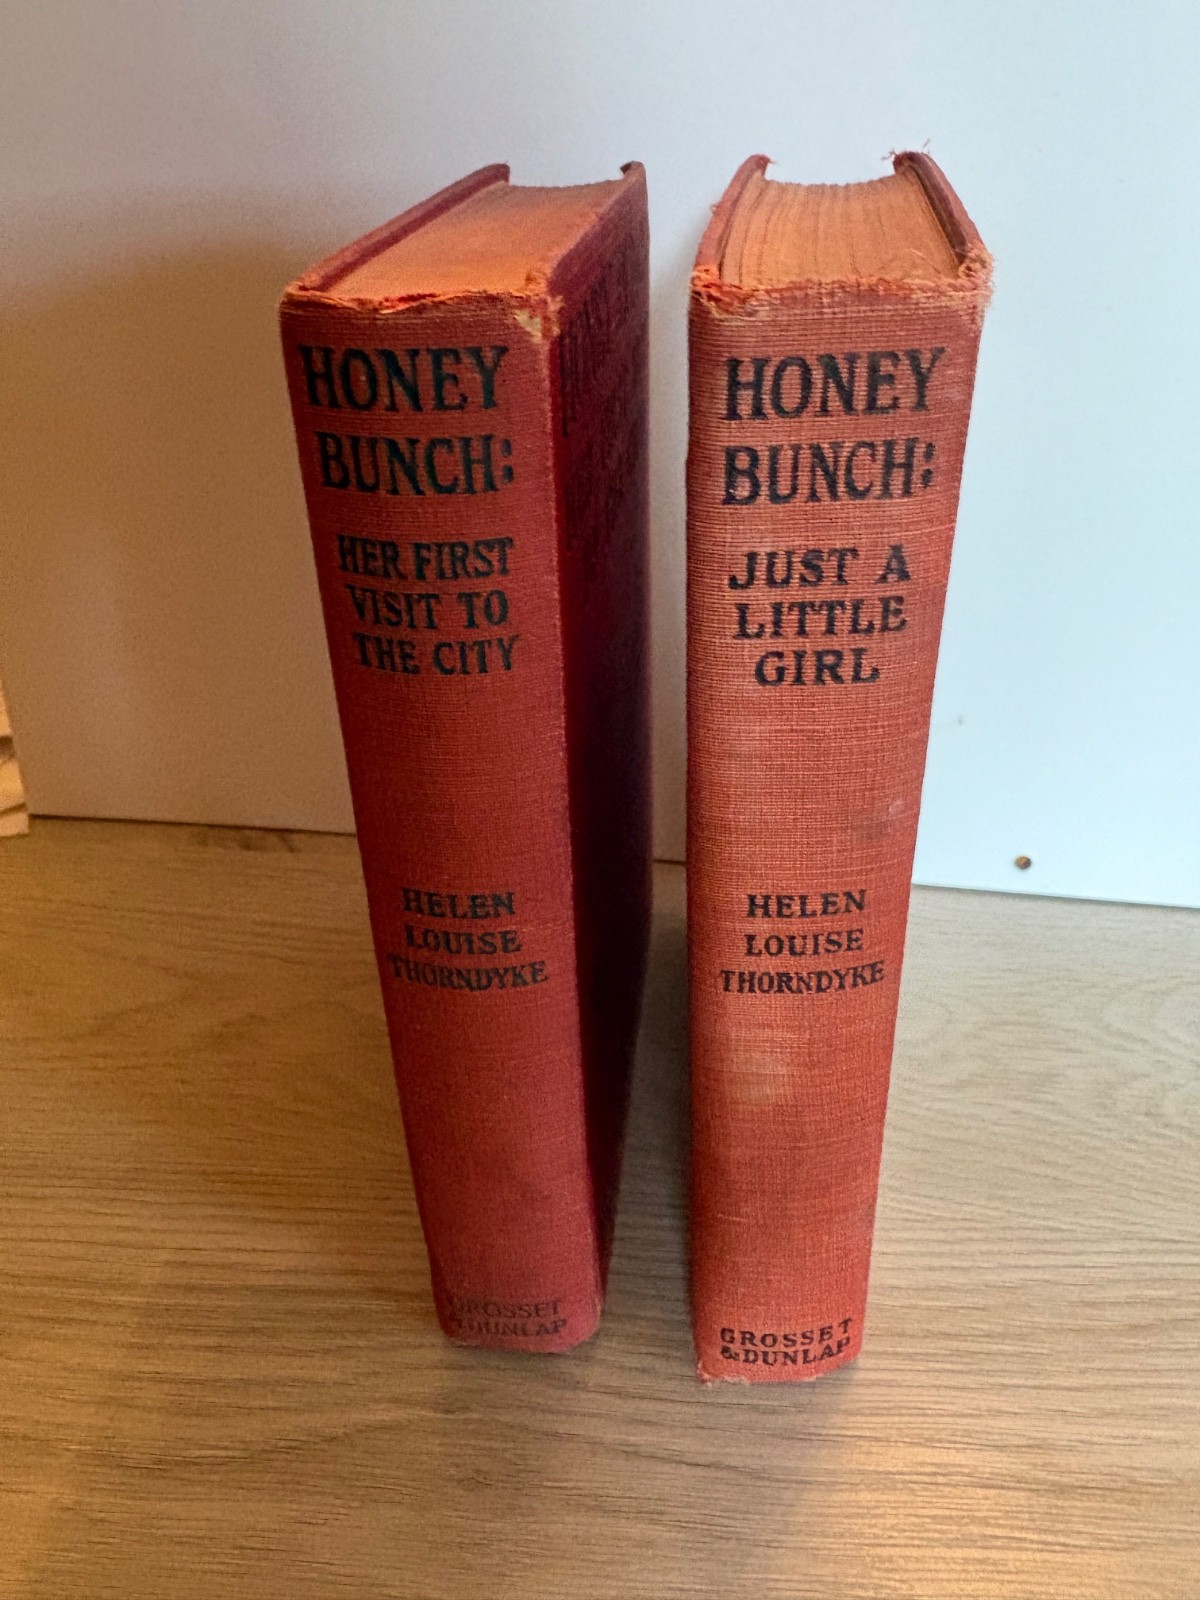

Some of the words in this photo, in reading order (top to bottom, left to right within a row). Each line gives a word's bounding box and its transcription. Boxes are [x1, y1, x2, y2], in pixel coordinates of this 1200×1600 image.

[297, 345, 509, 412] HONEY
[722, 347, 945, 421] HONEY
[314, 431, 514, 496] BUNCH:
[721, 437, 936, 505] BUNCH:
[337, 534, 407, 580] HER
[411, 536, 514, 580] FIRST
[728, 548, 859, 590] JUST
[876, 544, 911, 584] A
[346, 583, 441, 629] VISIT
[458, 589, 509, 629] TO
[732, 595, 907, 640] LITTLE
[352, 632, 420, 675] THE
[433, 634, 519, 675] CITY
[755, 648, 880, 686] GIRL
[402, 887, 515, 919] HELEN
[746, 889, 867, 918] HELEN
[404, 924, 522, 955] LOUISE
[744, 928, 864, 957] LOUISE
[388, 952, 548, 992] THORNDYKE
[720, 960, 884, 994] THORNDYKE
[720, 1318, 852, 1348] GROSSET
[720, 1336, 851, 1366] &DUNLAP
